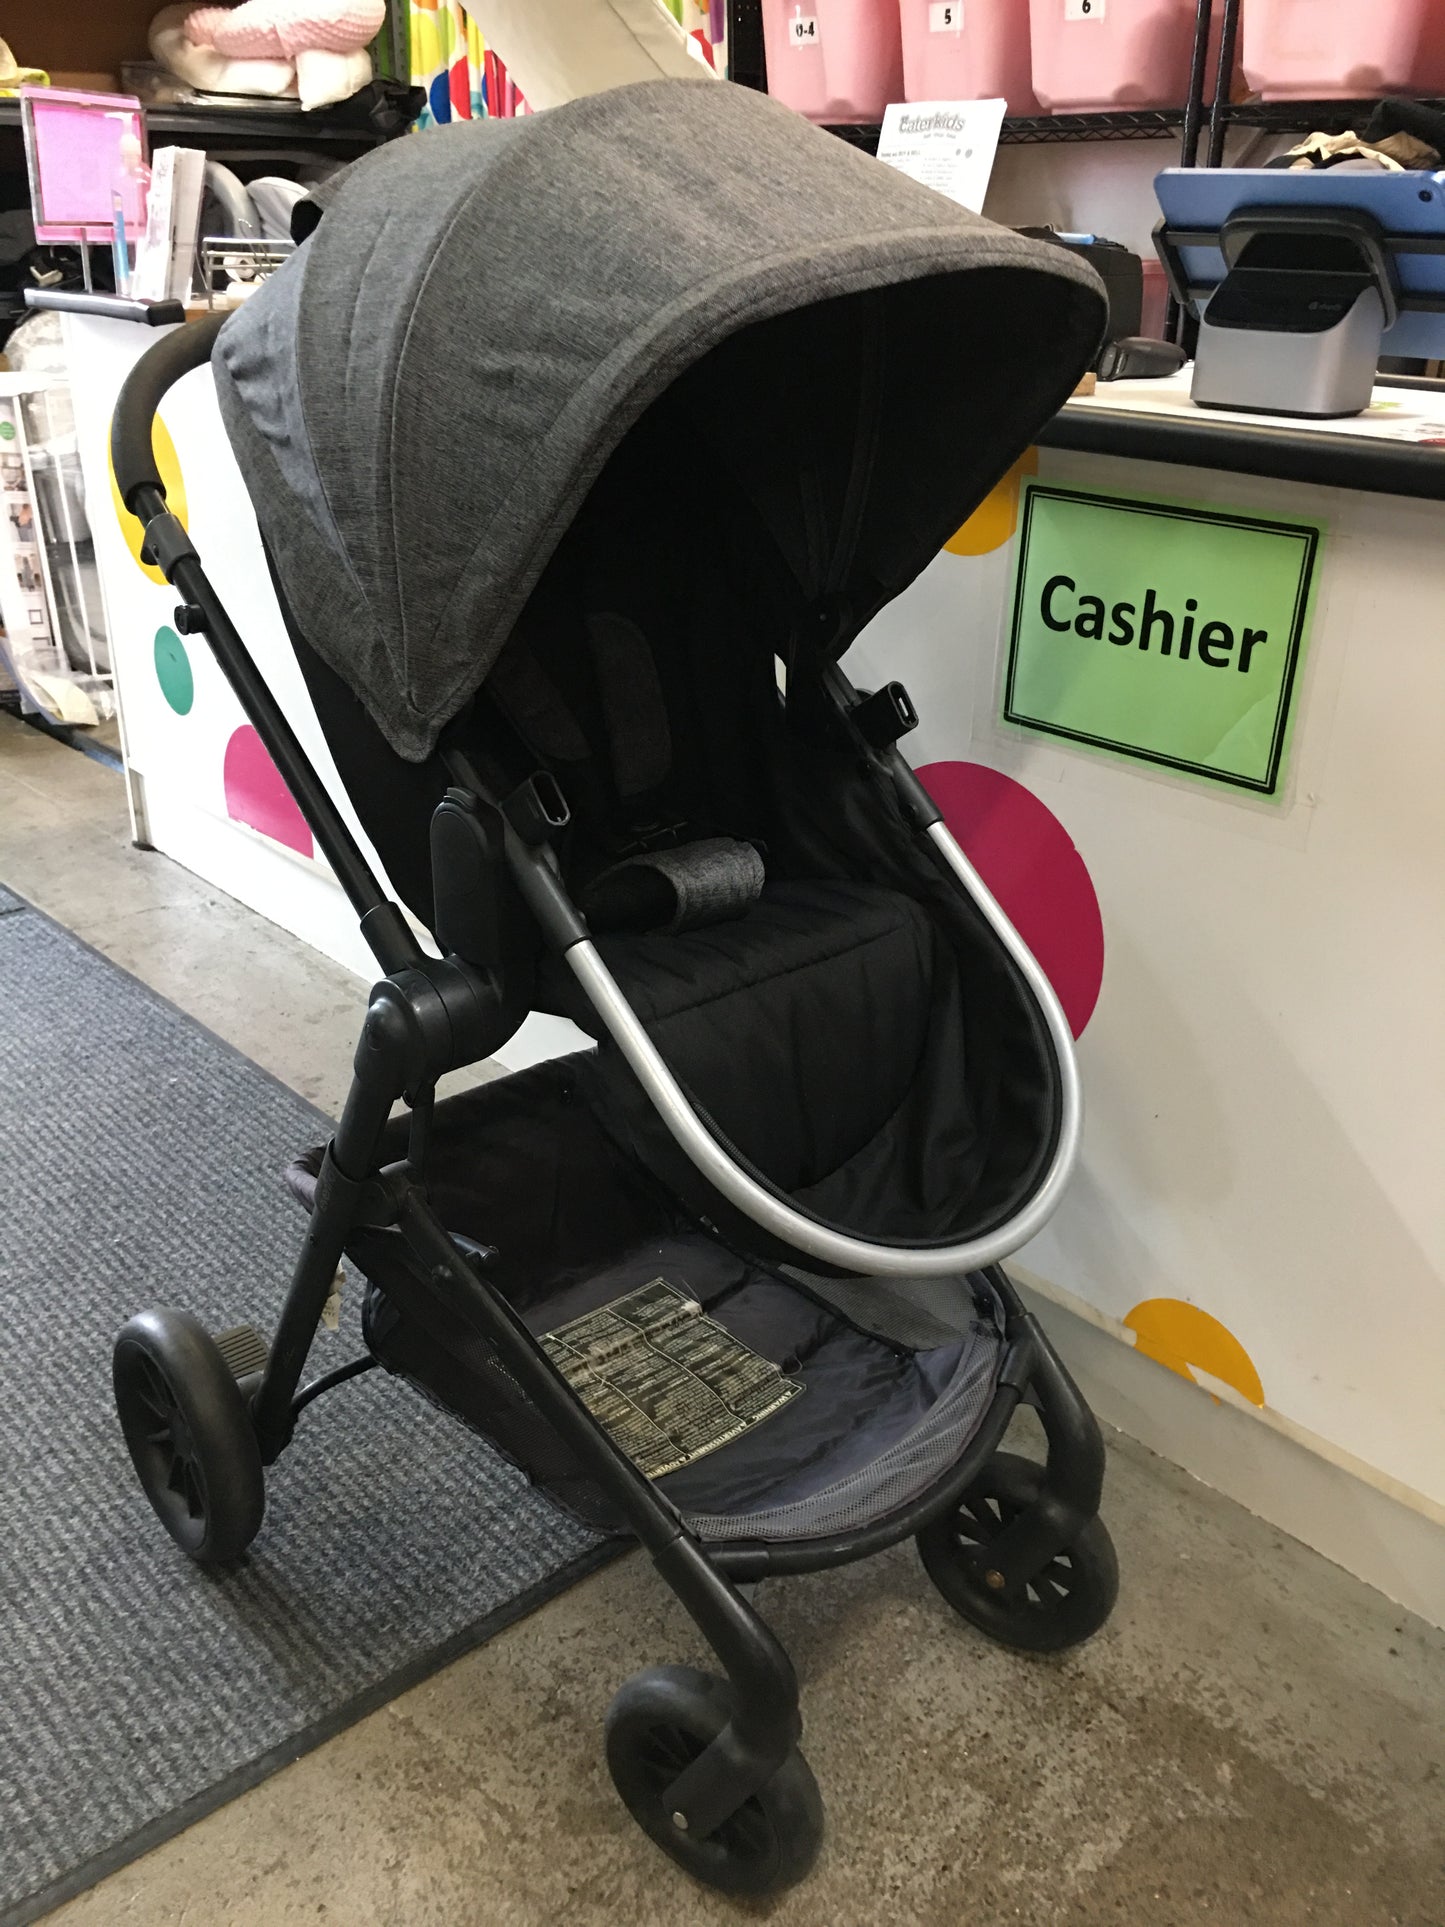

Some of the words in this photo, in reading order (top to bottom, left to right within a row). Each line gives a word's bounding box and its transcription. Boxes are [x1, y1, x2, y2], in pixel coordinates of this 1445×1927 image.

[1081, 0, 1092, 14] 6
[944, 8, 952, 25] 5
[1040, 574, 1268, 673] Cashier
